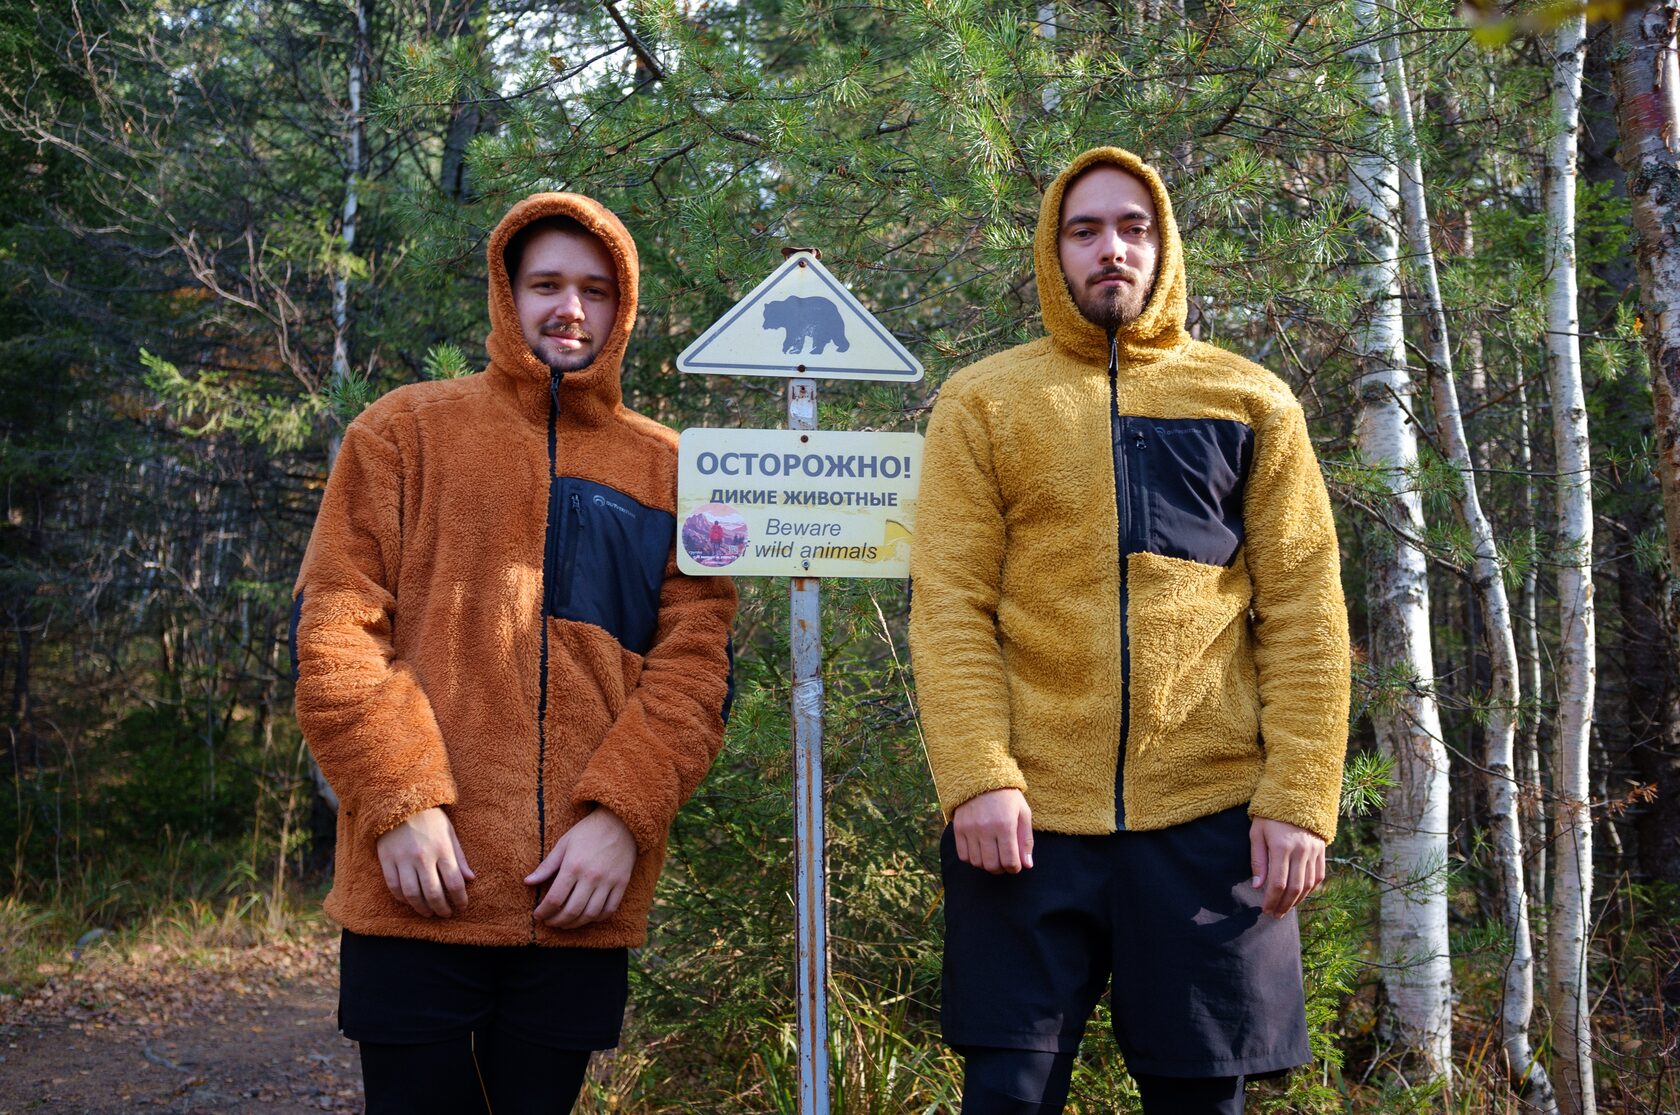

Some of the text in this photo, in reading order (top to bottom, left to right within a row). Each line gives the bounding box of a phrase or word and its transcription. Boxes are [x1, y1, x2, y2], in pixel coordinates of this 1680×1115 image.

[696, 452, 911, 479] ОСТОРОЖНО!
[709, 489, 898, 507] ДИКИЕ ЖИВОТНЫЕ
[765, 518, 842, 537] Beware
[755, 541, 794, 559] wild
[800, 542, 878, 560] animals
